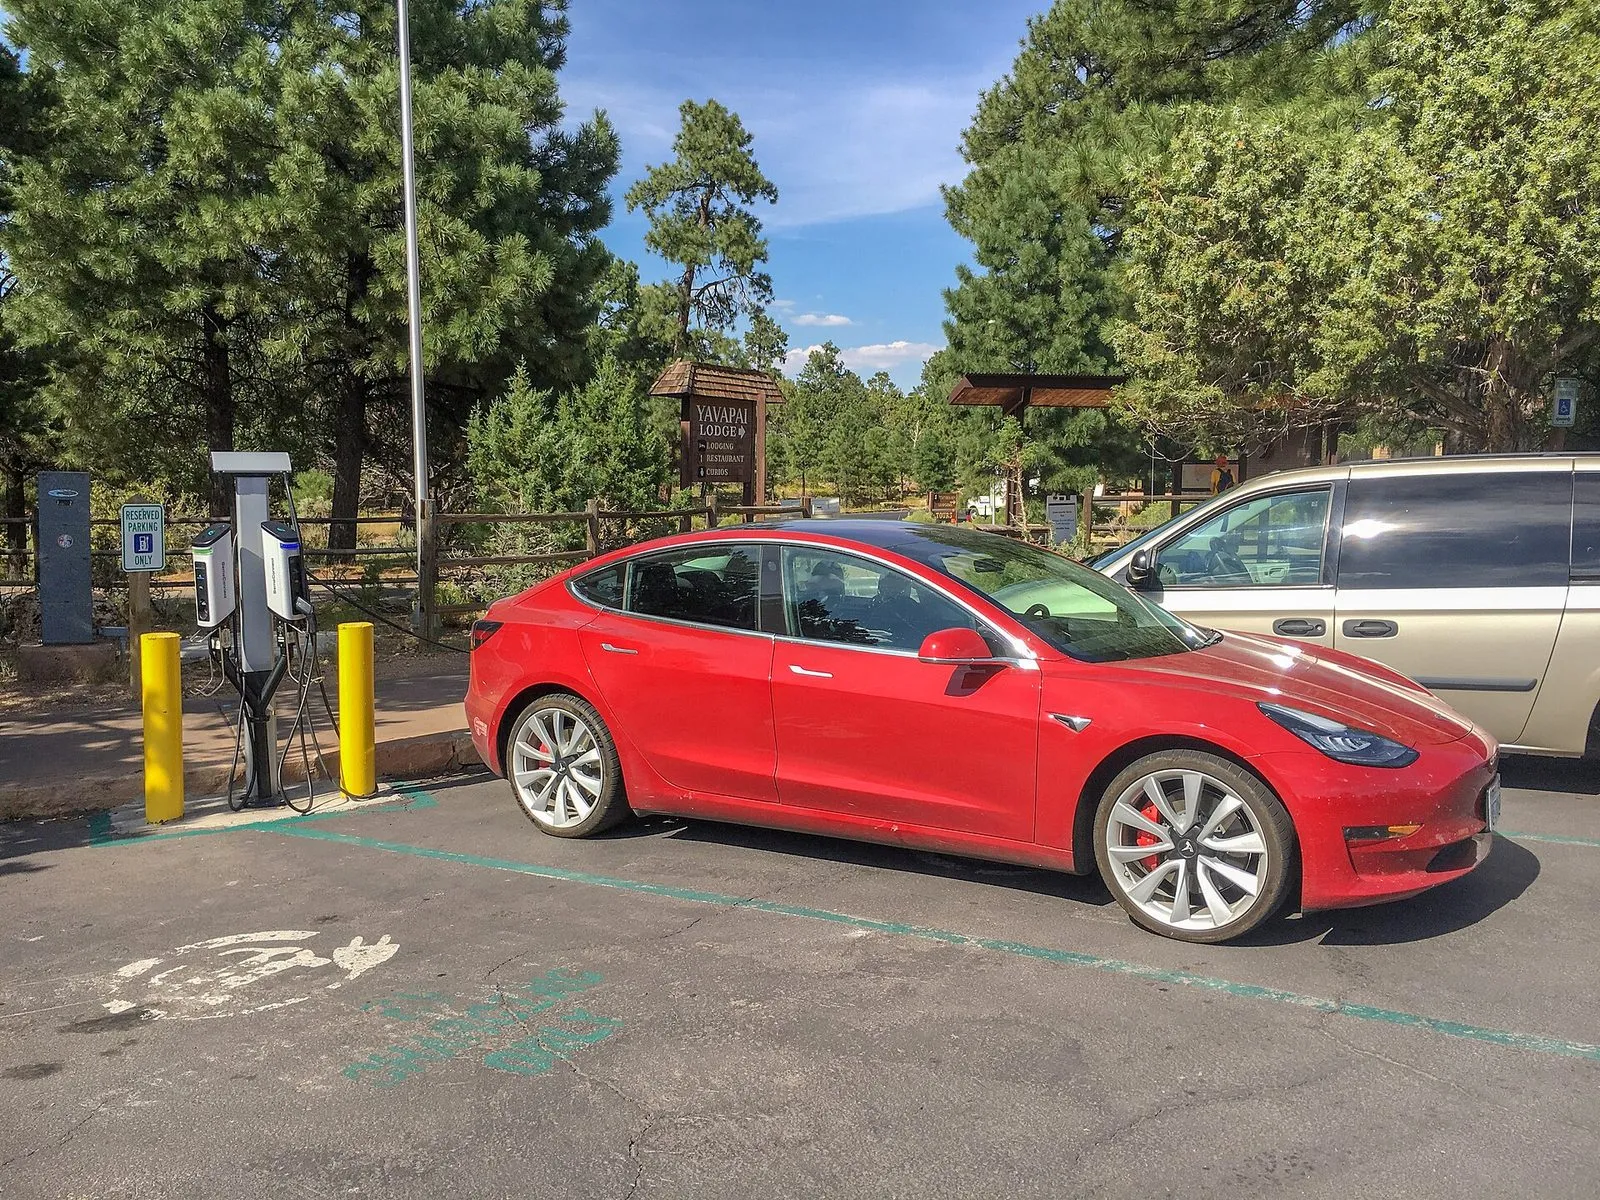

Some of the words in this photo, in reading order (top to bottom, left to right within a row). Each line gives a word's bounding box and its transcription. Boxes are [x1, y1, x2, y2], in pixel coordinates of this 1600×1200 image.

[697, 405, 748, 424] YAVAPAI
[700, 424, 737, 437] LODGE
[706, 442, 734, 450] LODGING
[706, 455, 744, 463] RESTAURANT
[706, 468, 729, 476] CURIOS
[126, 510, 160, 520] RESERVED
[128, 522, 158, 532] PARKING
[134, 555, 153, 565] ONLY
